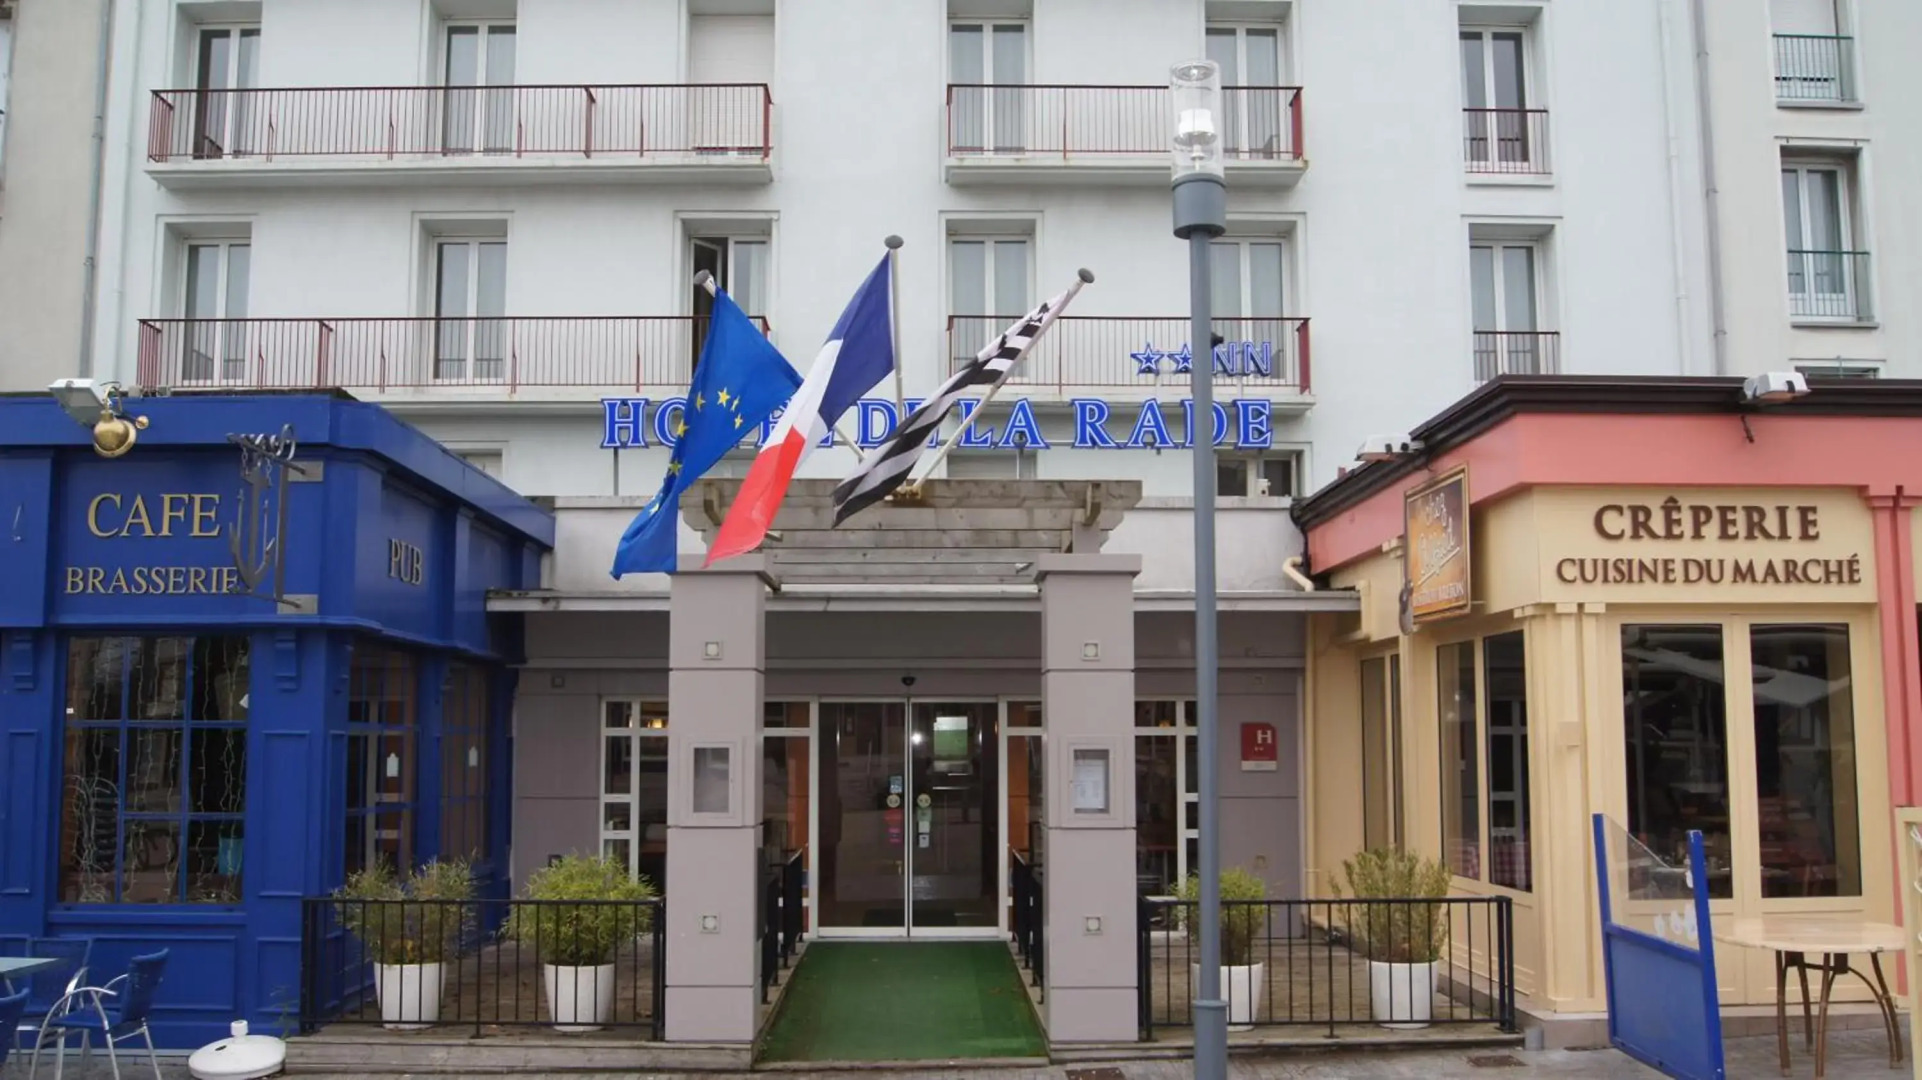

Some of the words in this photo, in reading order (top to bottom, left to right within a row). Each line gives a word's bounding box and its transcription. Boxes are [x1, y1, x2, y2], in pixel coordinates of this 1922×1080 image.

[856, 397, 940, 449] D
[957, 397, 1050, 449] LA
[1071, 397, 1273, 449] RADE
[87, 492, 221, 538] CAFE
[1593, 495, 1821, 541] CRÊPERIE
[64, 566, 240, 595] BRASSERIE
[388, 538, 422, 585] PUB
[1556, 557, 1678, 584] CUISINE
[1681, 558, 1726, 584] DU
[1730, 553, 1862, 584] MARCHÉ
[1256, 729, 1273, 744] H
